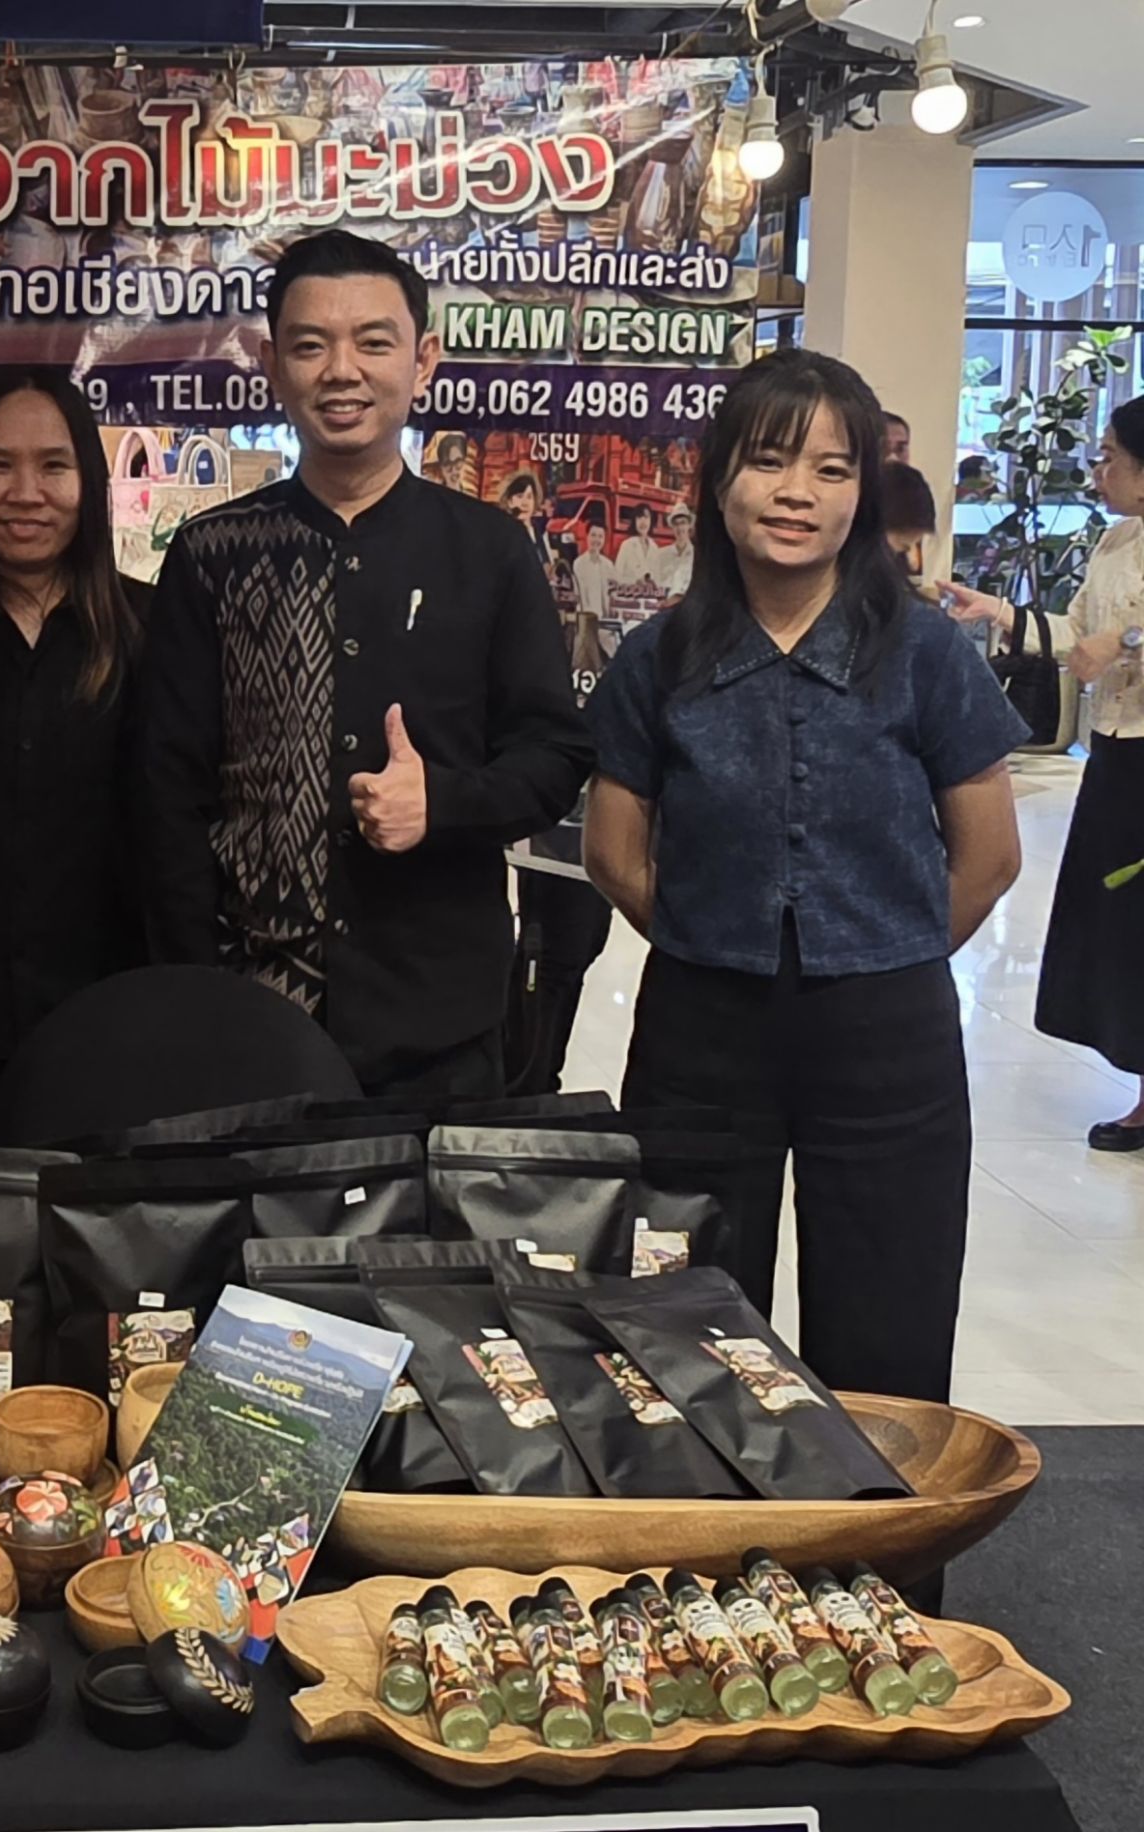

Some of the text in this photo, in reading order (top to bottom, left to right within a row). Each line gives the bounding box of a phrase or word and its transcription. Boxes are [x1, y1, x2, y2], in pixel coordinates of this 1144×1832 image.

[447, 306, 726, 355] KHAM DESIGN
[150, 374, 283, 412] TEL.08
[564, 381, 649, 418] 4986
[528, 432, 580, 462] 2569
